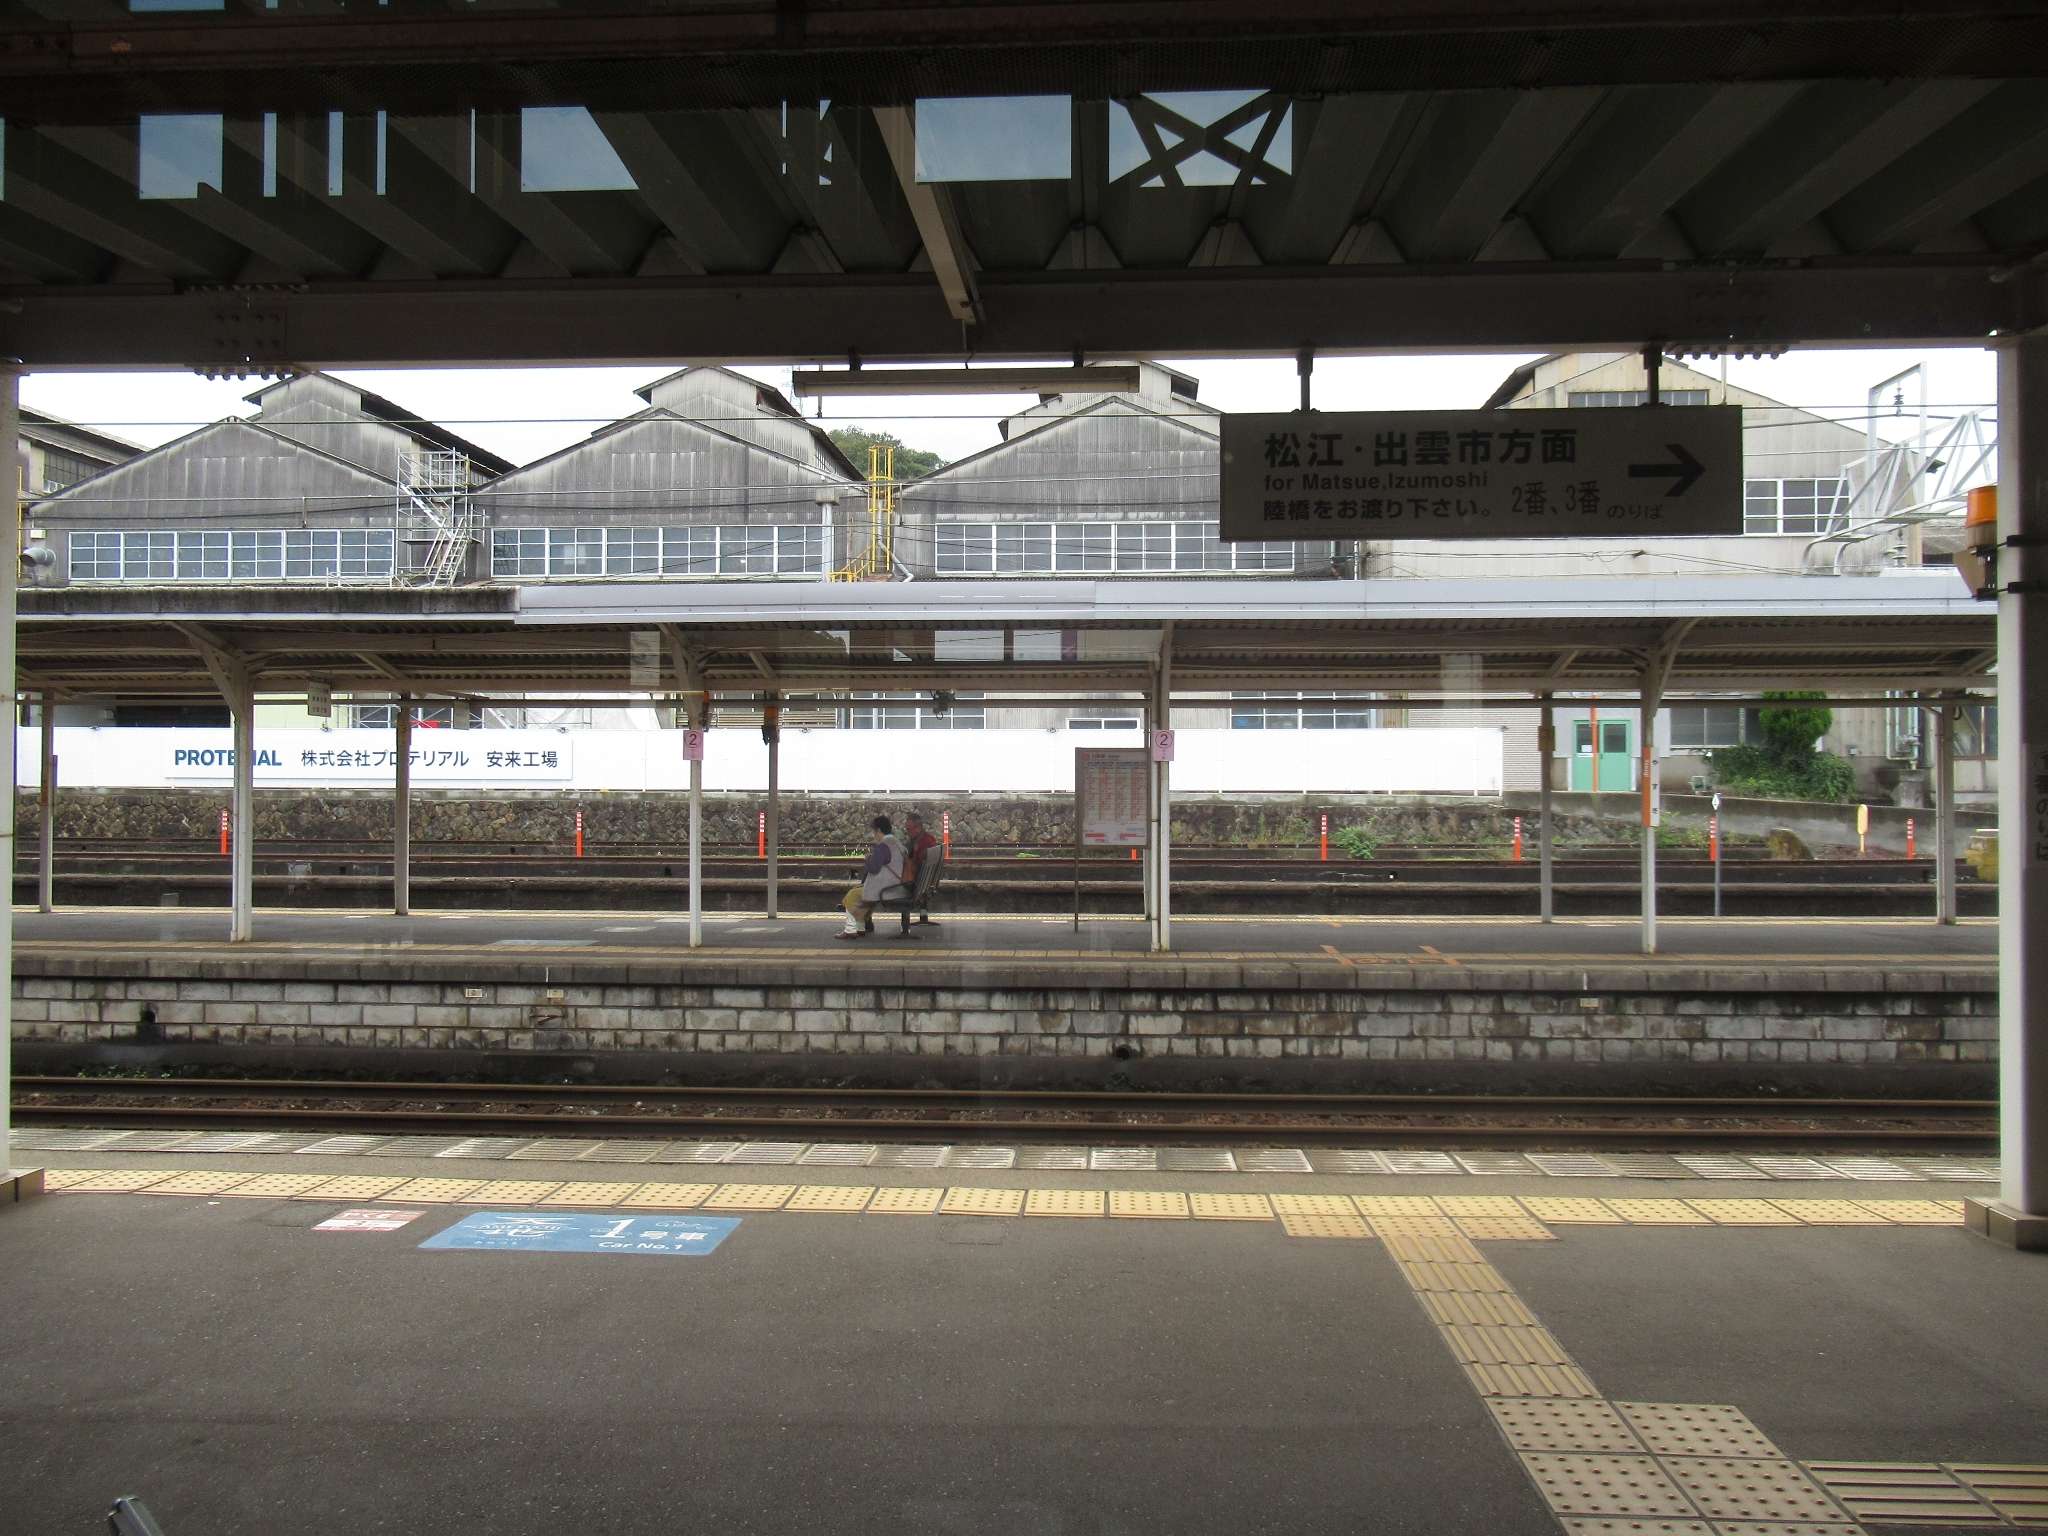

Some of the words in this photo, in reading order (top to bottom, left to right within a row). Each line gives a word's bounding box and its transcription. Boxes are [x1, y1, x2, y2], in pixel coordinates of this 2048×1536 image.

[1264, 428, 1578, 468] 松江・出雲市方面
[1264, 474, 1293, 492] for
[1263, 498, 1491, 521] 陸橋をお渡り下さい。
[175, 749, 282, 766] PROTEIAL
[486, 750, 559, 768] 安来工場
[598, 1241, 632, 1249] Car
